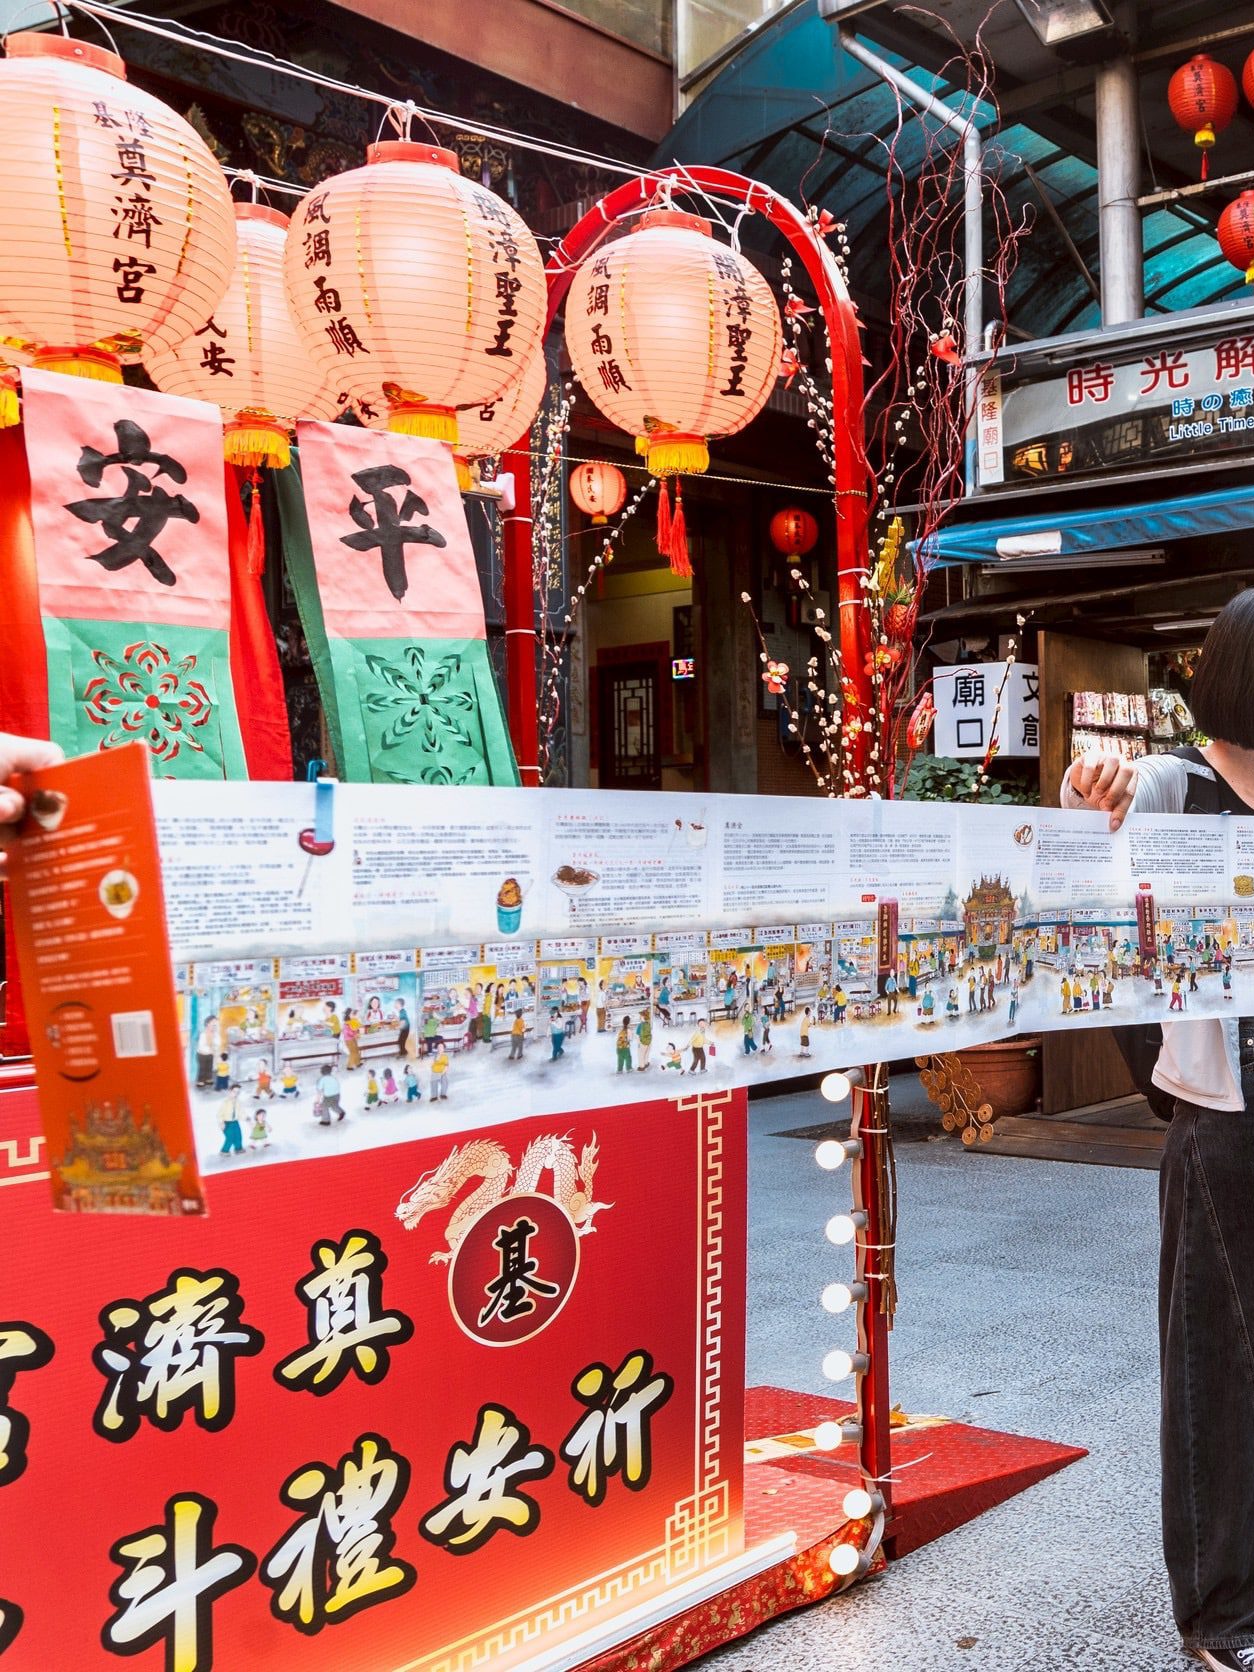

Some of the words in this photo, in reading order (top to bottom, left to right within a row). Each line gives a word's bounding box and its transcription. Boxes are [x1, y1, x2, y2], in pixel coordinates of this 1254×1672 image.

[92, 100, 154, 140] 基隆
[111, 135, 163, 304] 奠濟宮
[302, 190, 371, 359] 風調雨順
[472, 190, 523, 358] 開漳聖王
[586, 251, 633, 394] 風調雨順
[711, 252, 753, 397] 開漳聖王
[979, 376, 999, 471] 基隆廟口
[1168, 421, 1214, 441] Little
[63, 418, 201, 587] 安
[338, 463, 447, 601] 平
[952, 672, 985, 748] 廟口
[478, 1219, 559, 1328] 基
[0, 1349, 674, 1672] 祈安禮斗
